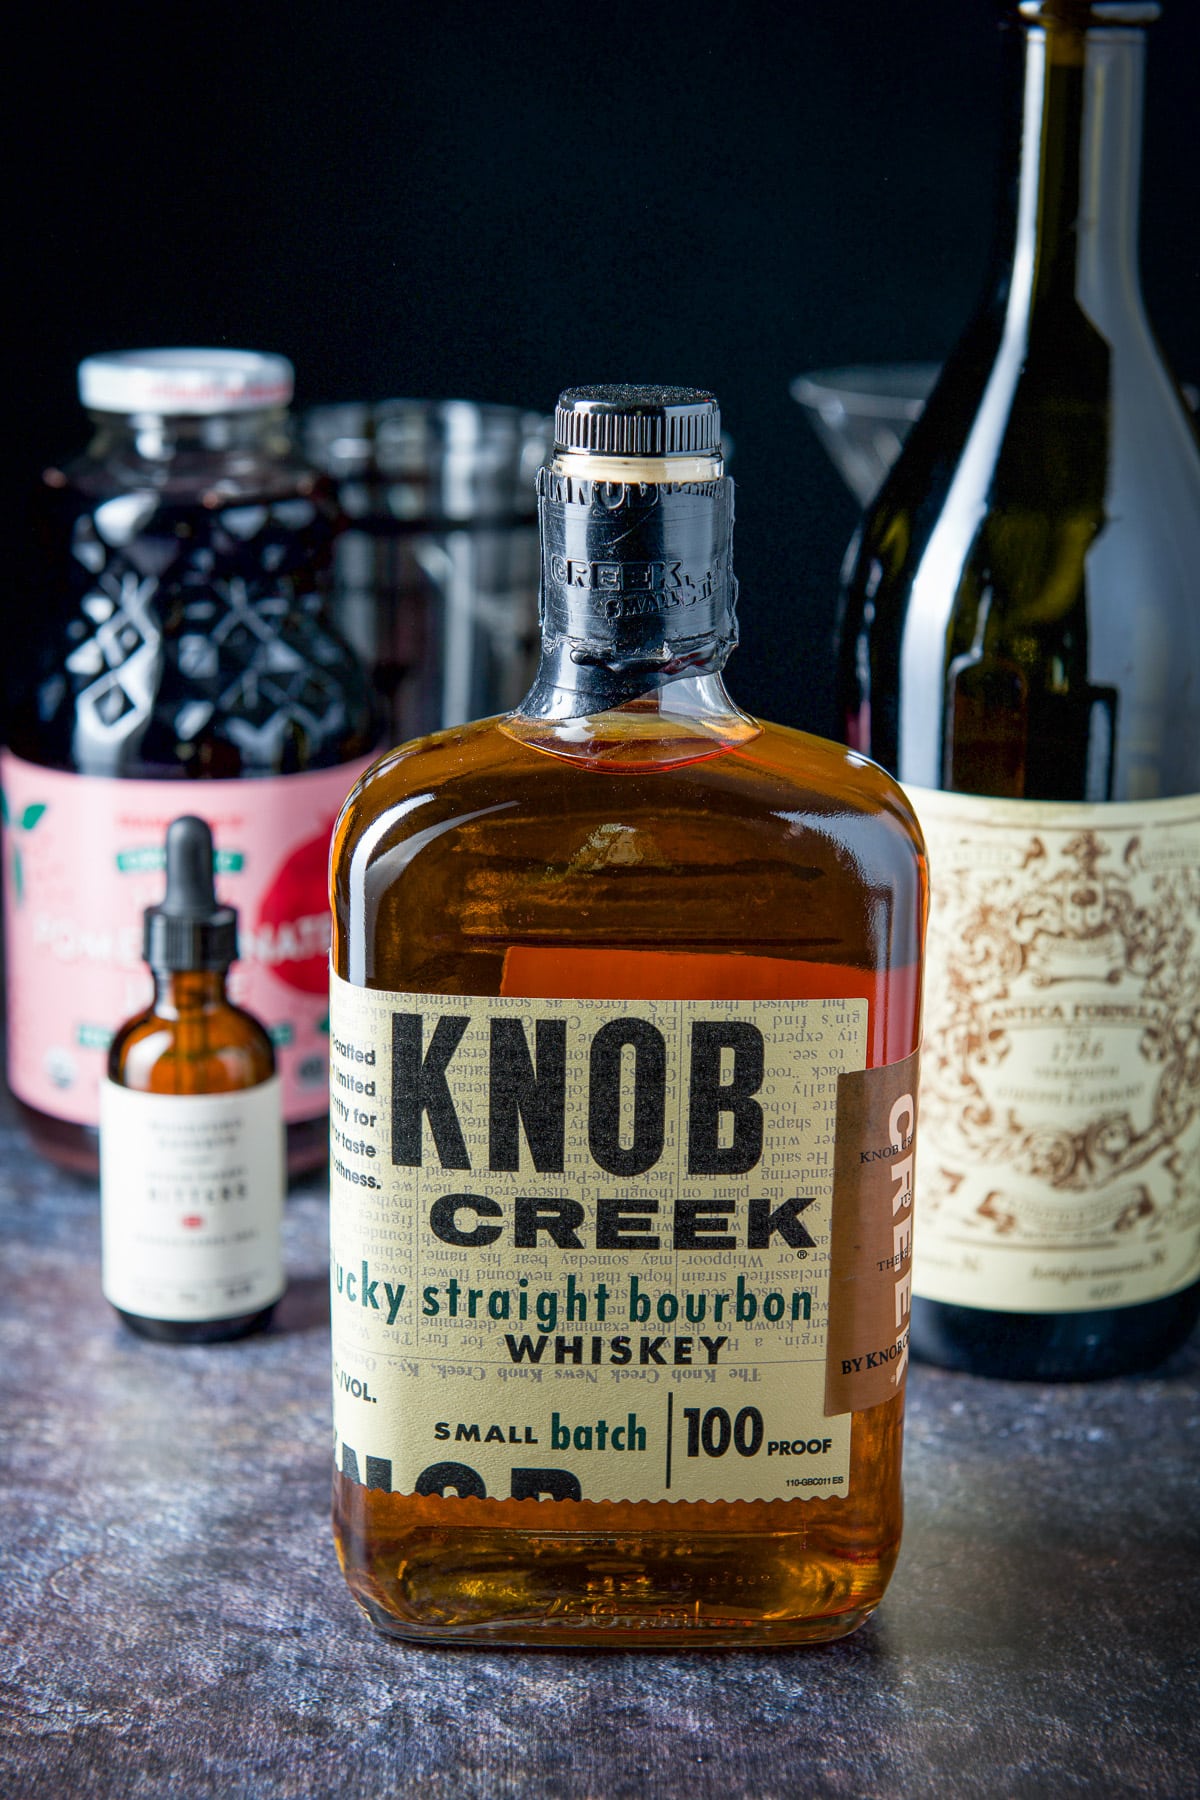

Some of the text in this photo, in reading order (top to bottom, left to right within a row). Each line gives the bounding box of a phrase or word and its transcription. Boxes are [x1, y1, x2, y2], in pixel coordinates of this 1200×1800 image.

[416, 996, 472, 1010] during
[545, 1000, 562, 1010] as
[577, 1000, 628, 1013] forces
[710, 1000, 738, 1011] that
[752, 1000, 808, 1012] advised
[773, 1015, 806, 1029] find
[764, 1029, 823, 1045] experts
[788, 1049, 843, 1061] to see.
[392, 1013, 764, 1176] KNOB
[354, 1108, 377, 1127] for
[768, 1116, 812, 1132] shape
[342, 1133, 376, 1158] taste
[765, 1136, 800, 1150] with
[771, 1152, 802, 1166] said
[806, 1151, 828, 1166] He
[860, 1143, 899, 1164] KNOB
[468, 1167, 516, 1184] Virgin
[392, 1180, 412, 1192] we
[422, 1183, 451, 1195] new
[464, 1186, 472, 1196] a
[485, 1186, 568, 1200] discovered
[614, 1185, 674, 1200] thought
[713, 1185, 749, 1200] plant
[682, 1188, 700, 1200] on
[760, 1188, 784, 1200] the
[430, 1193, 816, 1250] CREEK
[420, 1249, 672, 1268] may someday bear his name.
[682, 1252, 763, 1268] Whippoor-
[777, 1254, 794, 1264] or
[374, 1263, 412, 1278] loves
[421, 1266, 469, 1282] flower
[591, 1272, 620, 1284] that
[682, 1272, 726, 1285] strain
[335, 1261, 406, 1325] ucky
[423, 1275, 610, 1333] straight
[630, 1276, 812, 1323] bourbon
[420, 1317, 496, 1333] determine
[508, 1321, 523, 1333] to
[680, 1322, 706, 1334] dis-
[718, 1322, 732, 1332] to
[744, 1320, 794, 1332] known
[382, 1330, 412, 1346] The
[420, 1333, 448, 1348] fur-
[460, 1335, 484, 1348] for
[754, 1338, 762, 1348] a
[505, 1334, 728, 1364] WHISKEY
[842, 1357, 863, 1375] BY
[866, 1340, 903, 1369] KNOB
[431, 1364, 486, 1381] Creek,
[497, 1368, 543, 1382] Knob
[554, 1369, 598, 1383] News
[610, 1369, 660, 1383] Creek
[672, 1369, 716, 1383] Knob
[728, 1368, 761, 1382] The
[434, 1412, 647, 1451] SMALL batch
[684, 1406, 832, 1458] 100 PROOF
